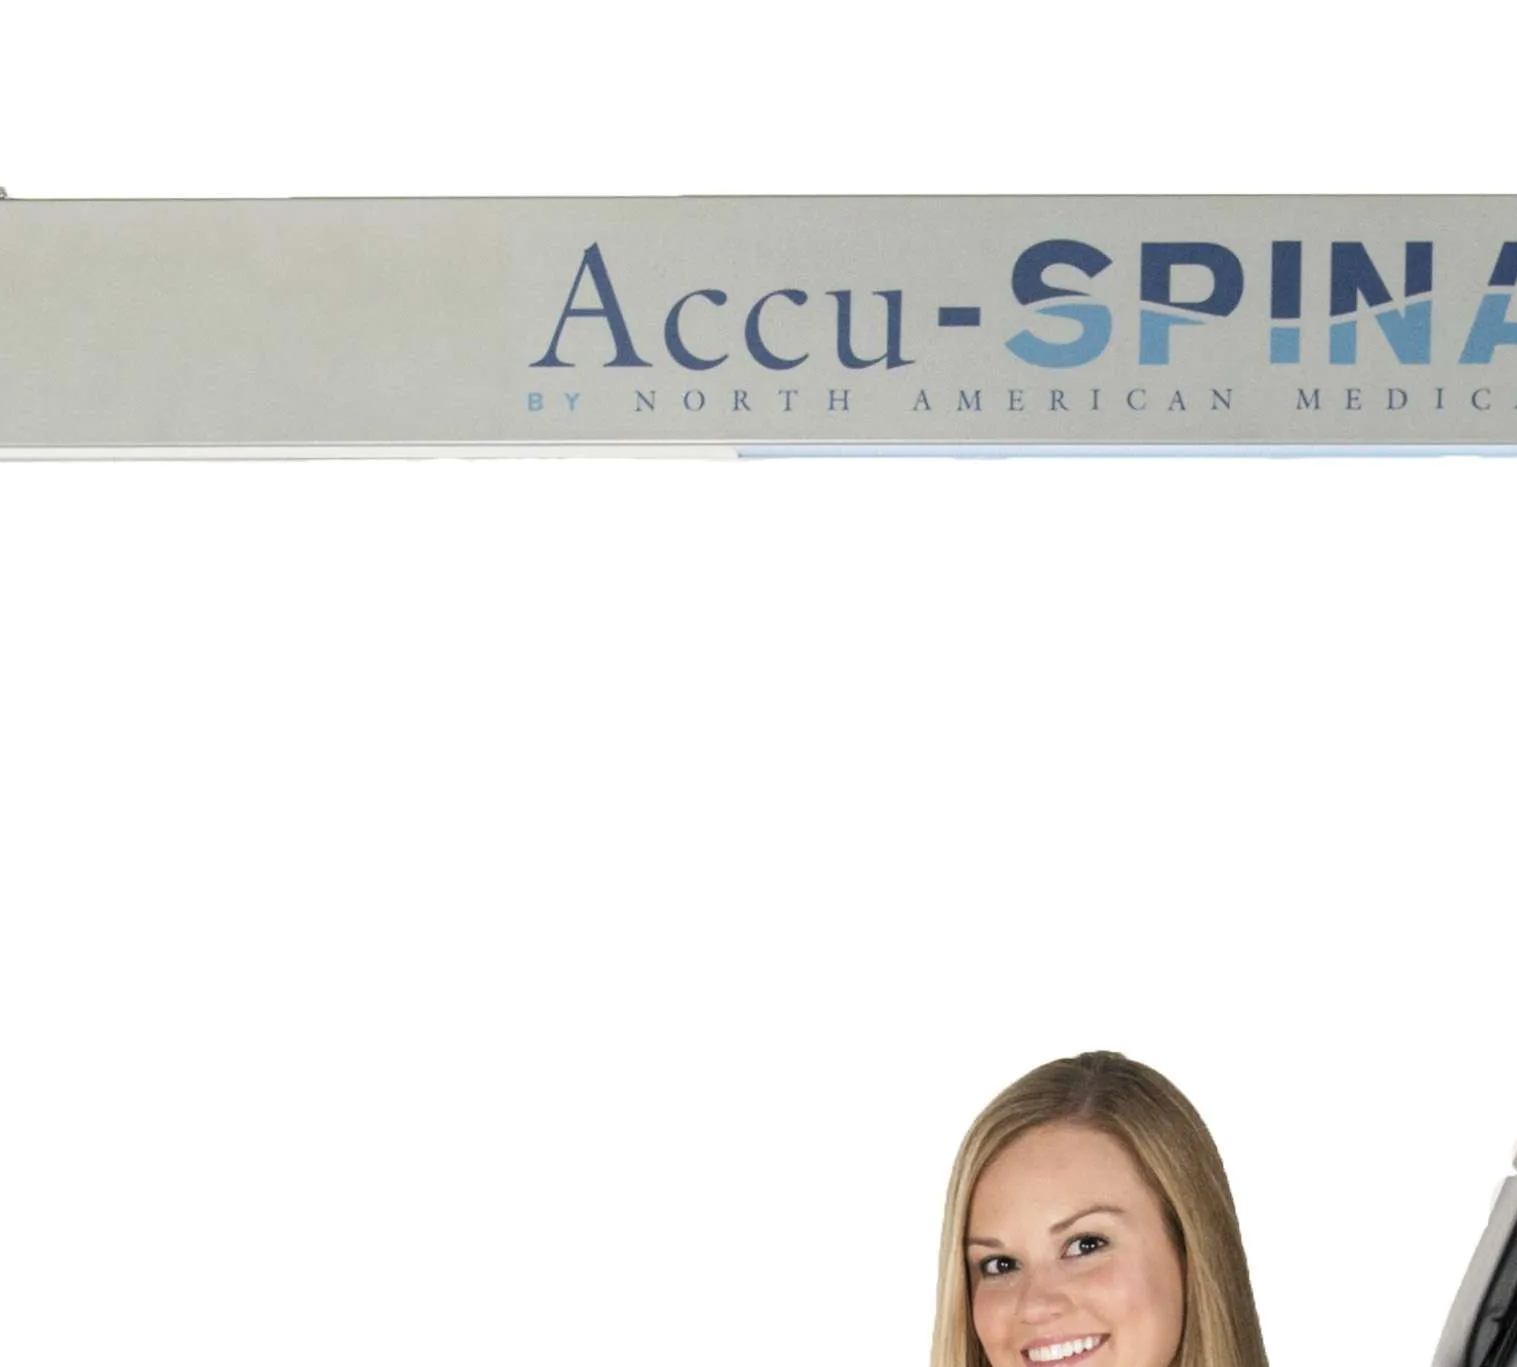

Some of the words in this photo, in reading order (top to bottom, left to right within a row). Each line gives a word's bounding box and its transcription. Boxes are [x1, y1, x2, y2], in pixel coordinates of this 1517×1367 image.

[527, 390, 581, 413] BY
[635, 388, 854, 413] NORTH
[913, 387, 1236, 413] AMERICAN
